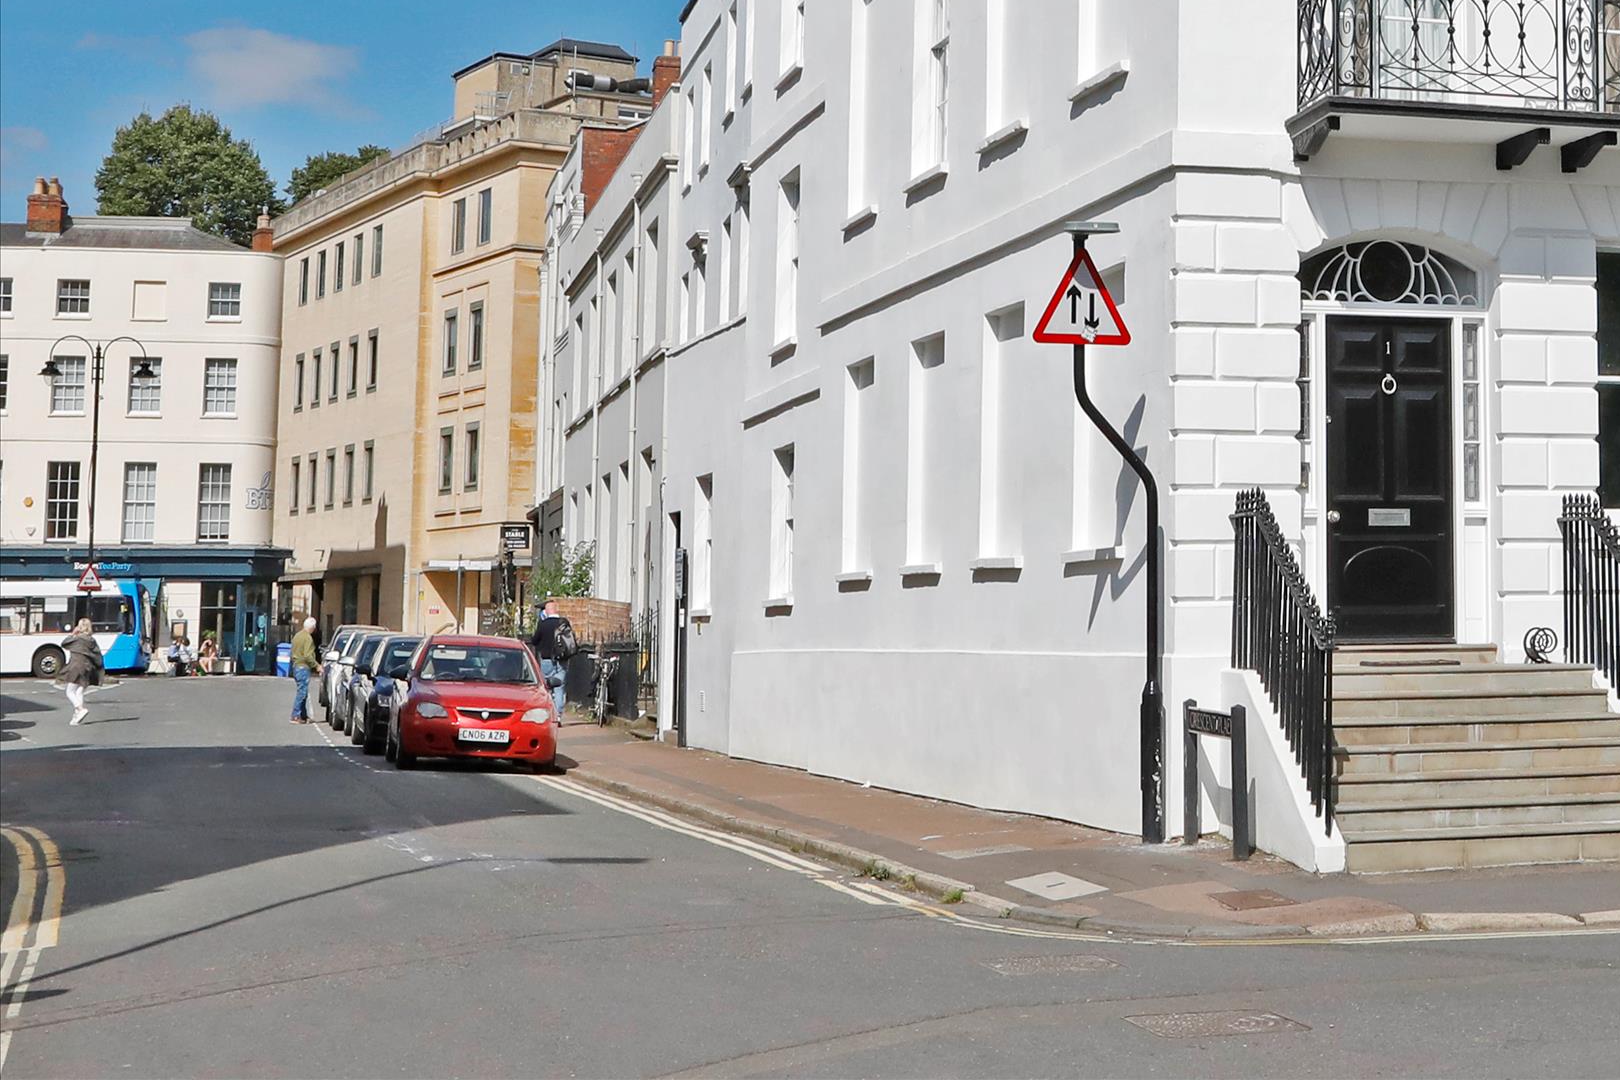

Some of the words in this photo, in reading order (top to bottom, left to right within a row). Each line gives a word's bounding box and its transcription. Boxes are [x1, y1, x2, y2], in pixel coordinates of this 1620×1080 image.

[1386, 341, 1391, 355] 1
[462, 730, 486, 740] CN06
[488, 731, 506, 741] AZR
